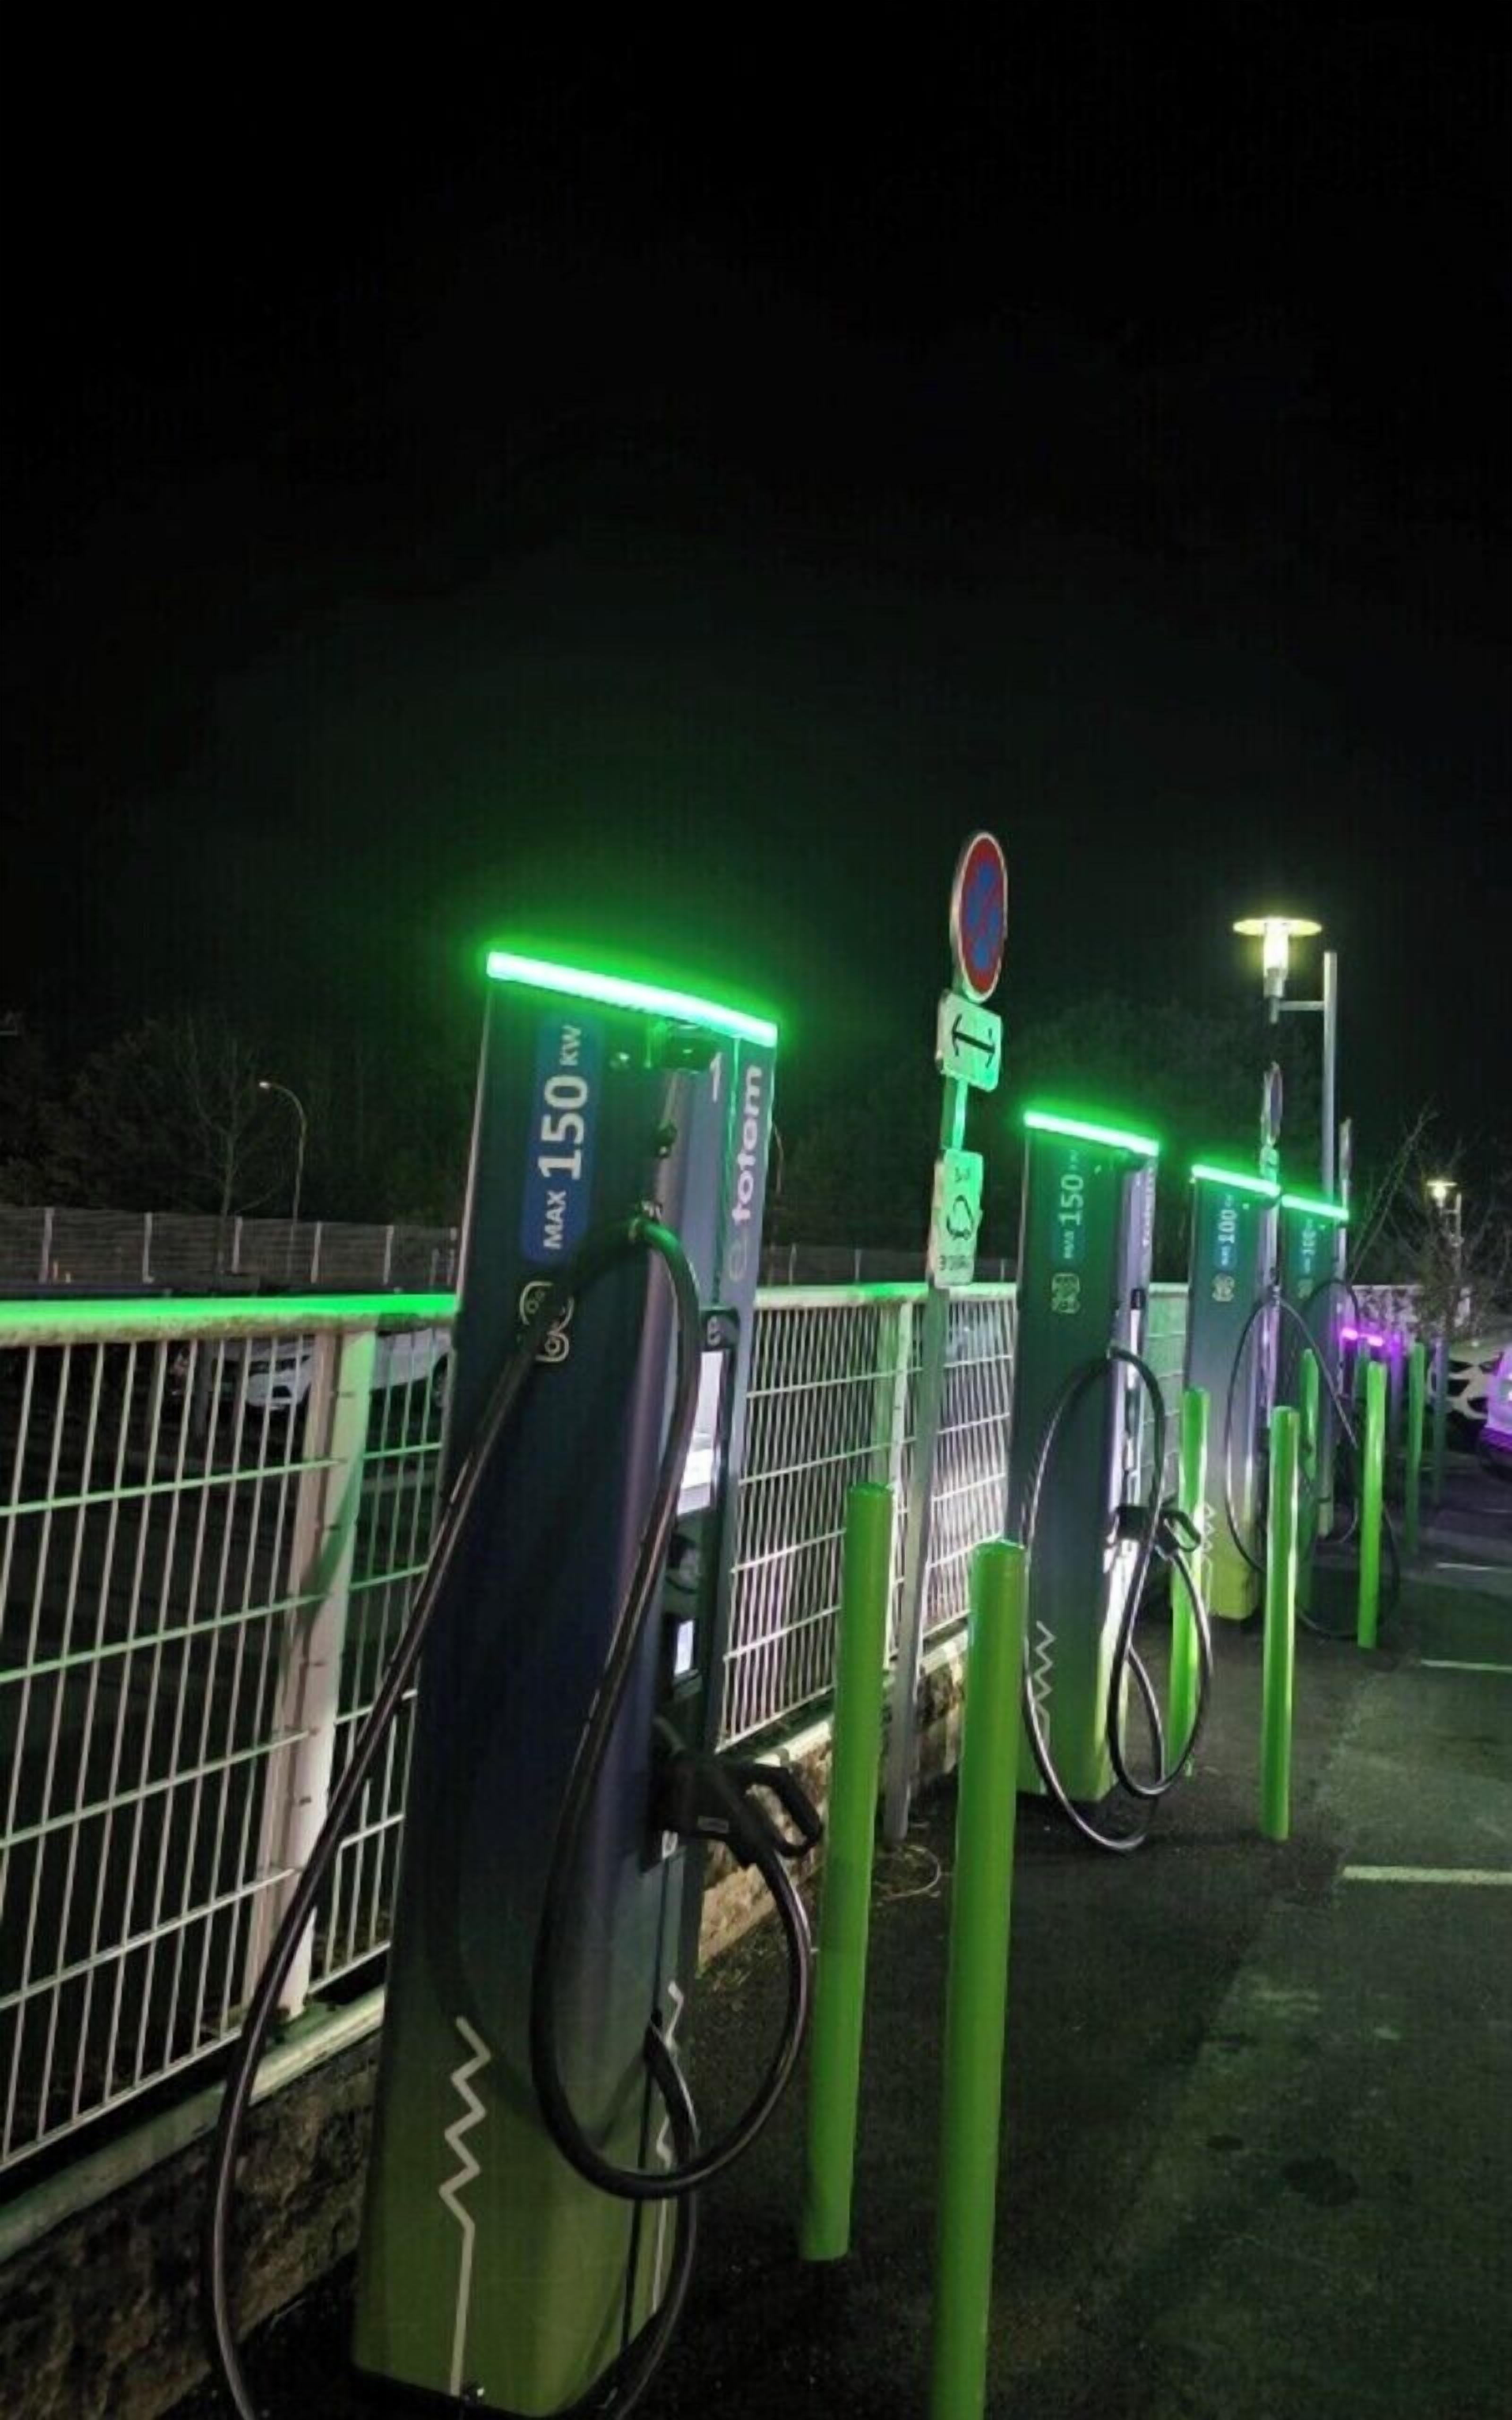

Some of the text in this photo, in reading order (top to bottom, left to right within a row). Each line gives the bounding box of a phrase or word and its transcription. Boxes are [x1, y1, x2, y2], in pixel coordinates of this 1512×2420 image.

[539, 1076, 588, 1179] 150
[543, 1191, 567, 1249] MAX
[1057, 1174, 1084, 1226] 150
